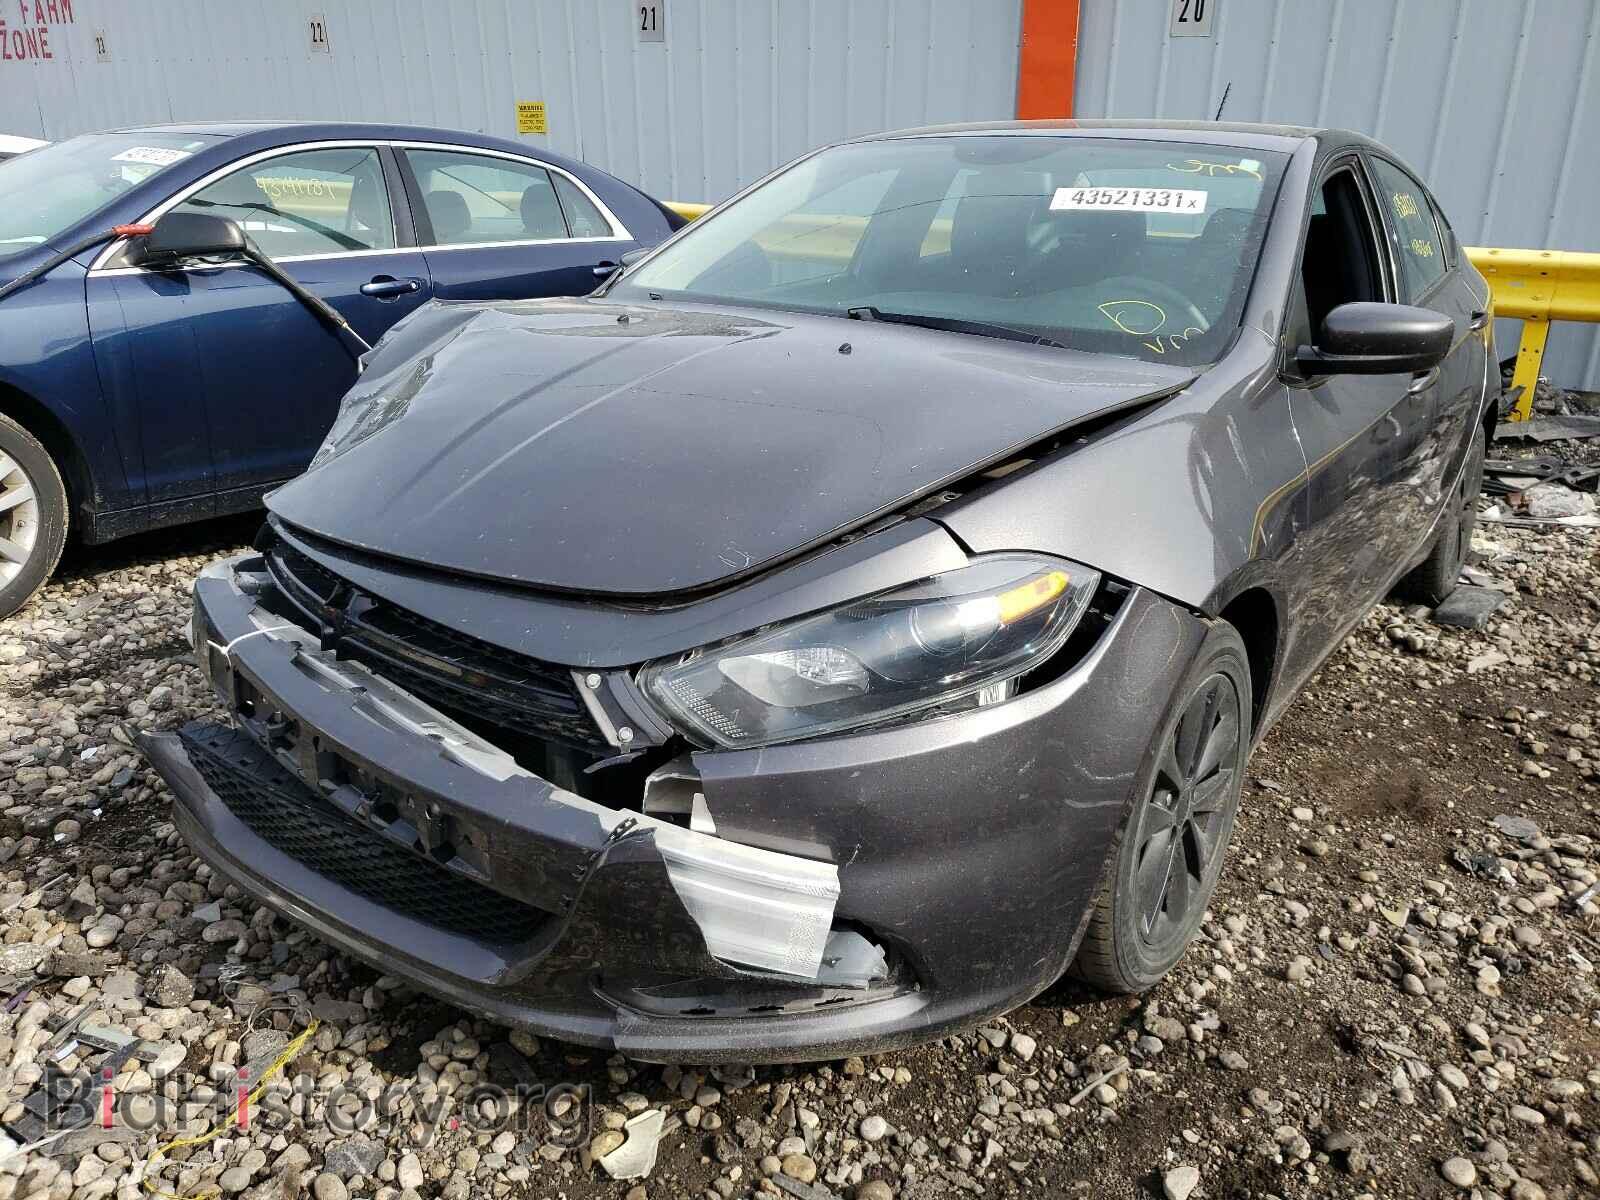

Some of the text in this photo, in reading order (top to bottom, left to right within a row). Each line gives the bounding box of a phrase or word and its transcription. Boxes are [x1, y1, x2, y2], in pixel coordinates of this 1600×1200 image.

[641, 7, 656, 31] 21
[1178, 0, 1205, 22] 20
[310, 22, 324, 42] 22
[0, 27, 53, 60] ZONE
[1071, 190, 1184, 208] 43521331
